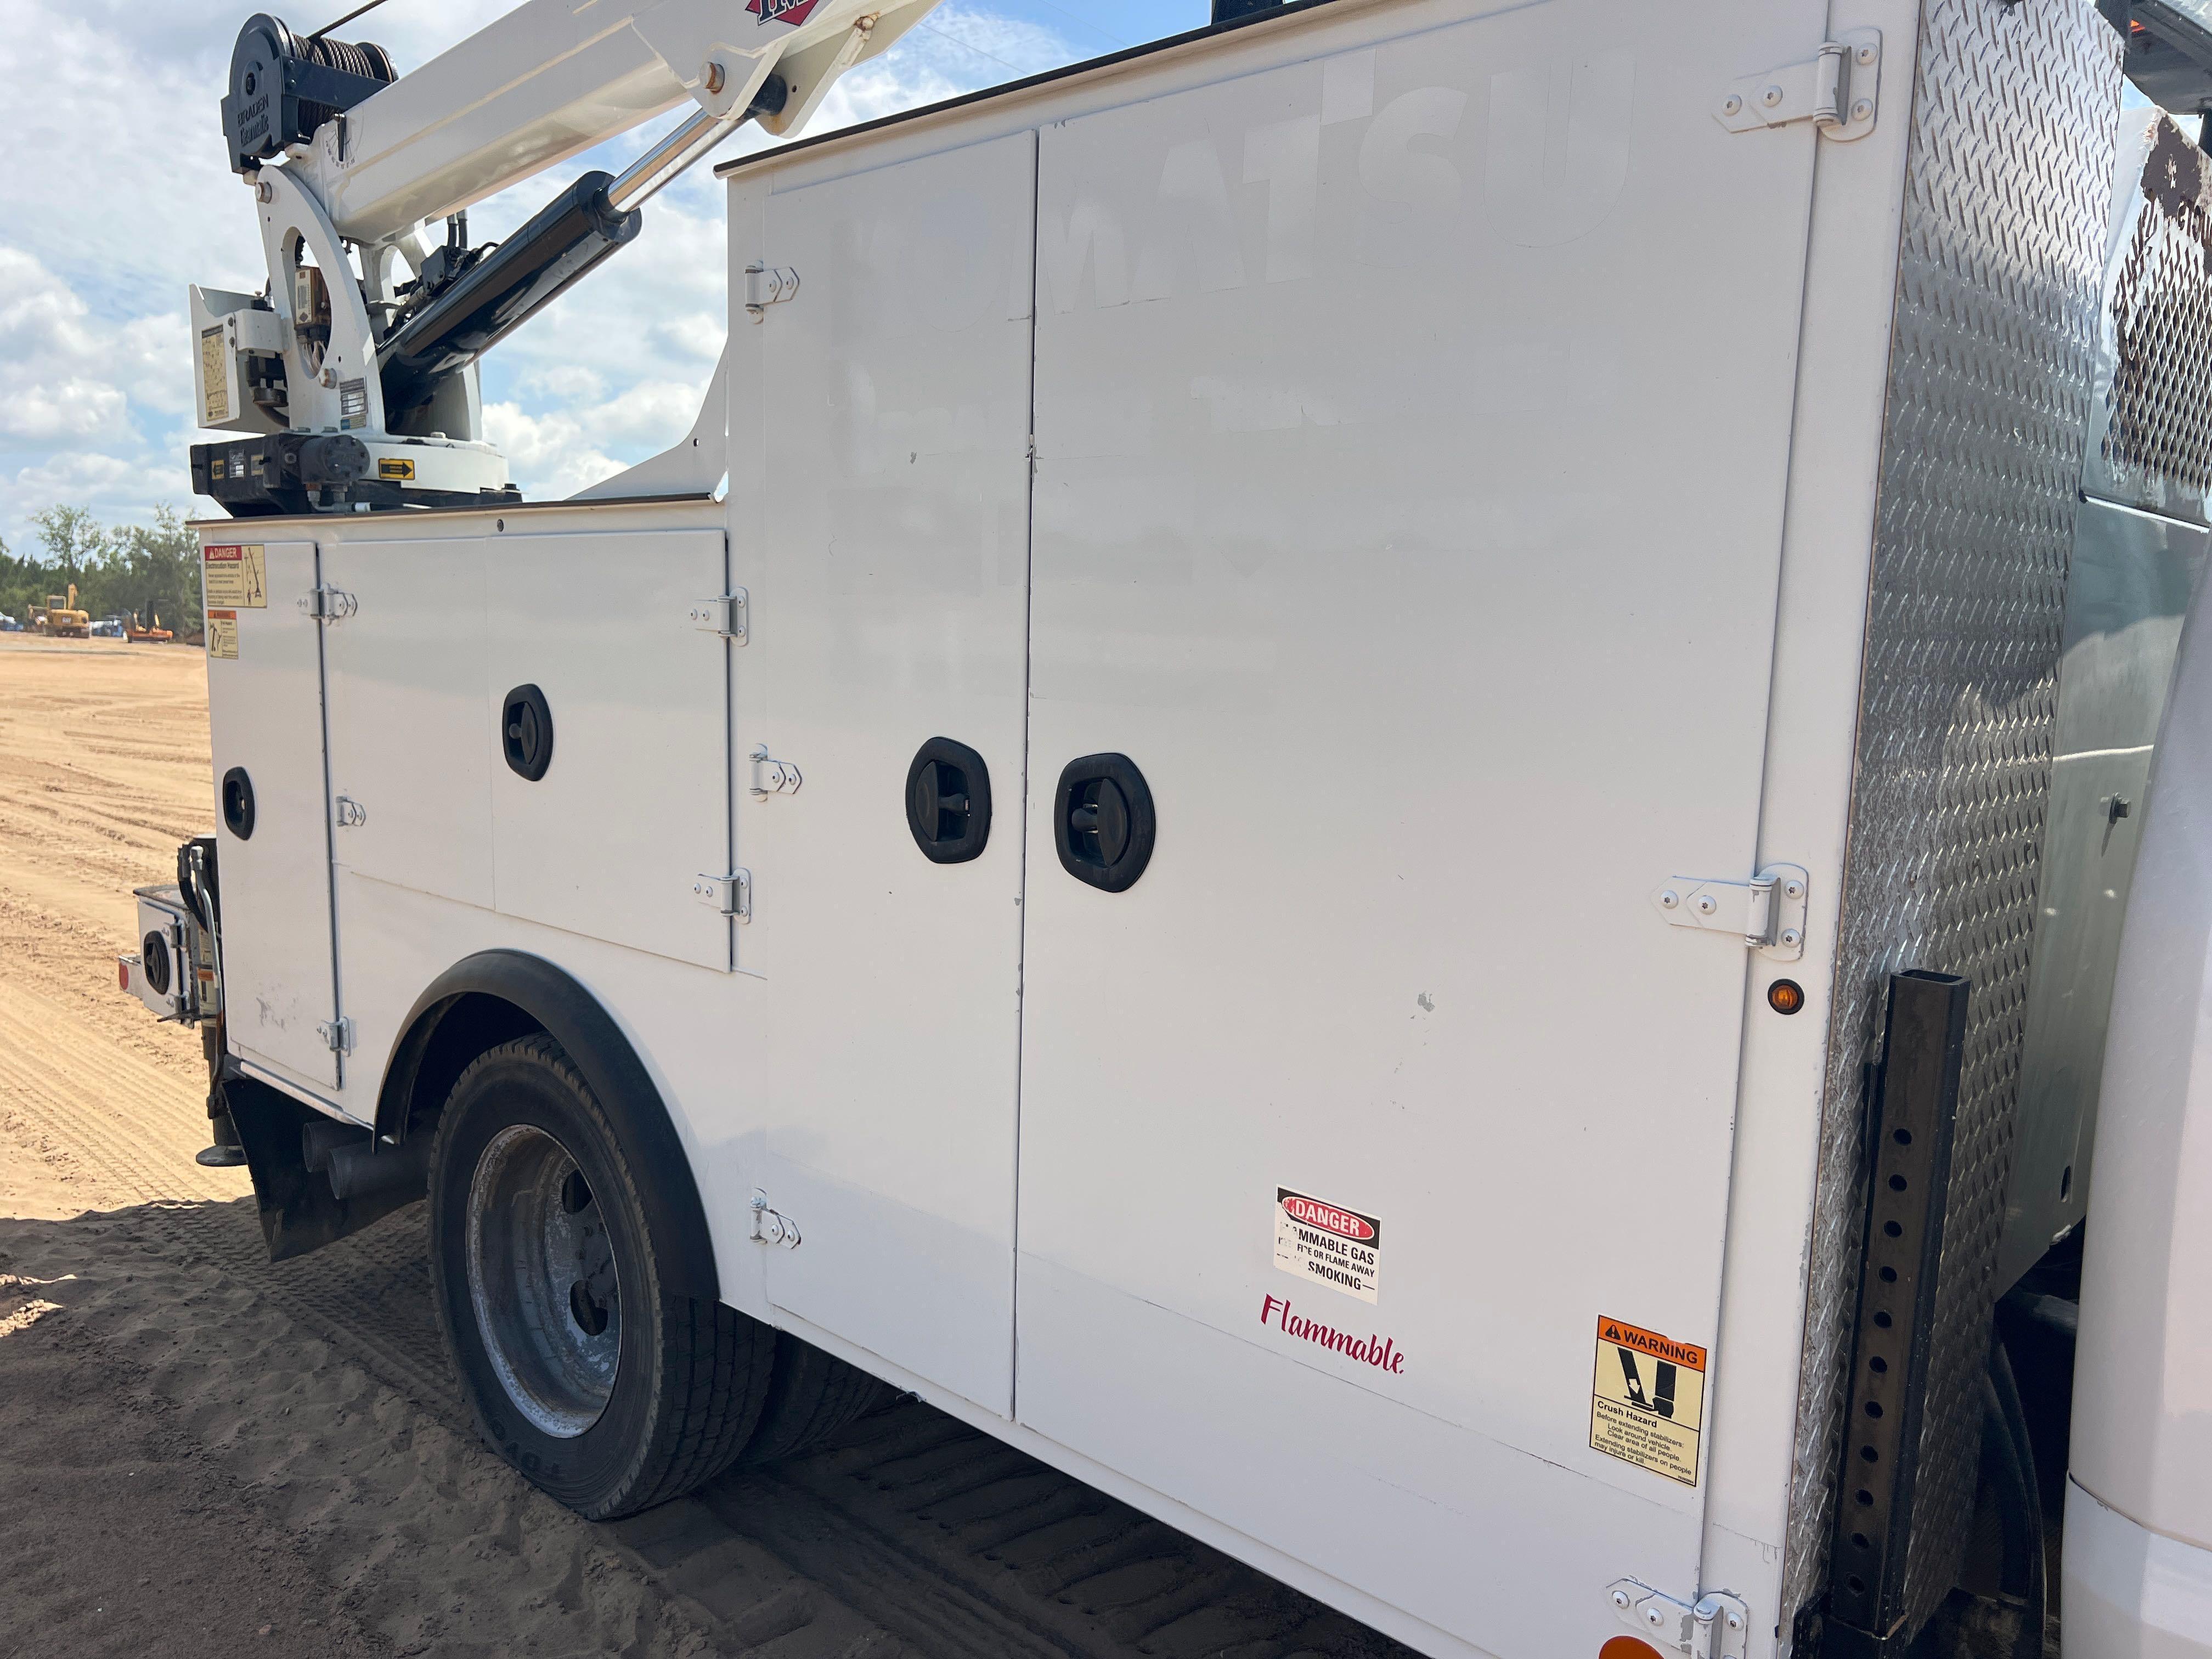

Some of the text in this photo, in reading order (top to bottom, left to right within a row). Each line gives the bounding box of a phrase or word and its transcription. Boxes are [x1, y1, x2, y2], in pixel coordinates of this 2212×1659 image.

[238, 92, 269, 127] BRADEN
[215, 547, 237, 558] DANGER
[1295, 1200, 1359, 1237] DANGER
[1313, 1249, 1324, 1260] OR
[1325, 1253, 1350, 1269] FLAME
[1351, 1263, 1375, 1278] AWAY
[1351, 1246, 1374, 1265] GAS
[1308, 1261, 1361, 1290] SMOKING
[1624, 1329, 1697, 1364] WARNING
[1598, 1401, 1657, 1427] Crush Hazard
[1596, 1411, 1684, 1448] Before extending stabilizers:
[1607, 1423, 1672, 1452] Look around vehicle.
[1594, 1442, 1608, 1452] may
[1609, 1446, 1626, 1457] injure
[1635, 1455, 1646, 1465] kill.
[1595, 1434, 1626, 1451] Extending
[1627, 1447, 1658, 1463] stabilizers
[1669, 1463, 1691, 1475] people
[1607, 1430, 1624, 1440] Clear
[1625, 1437, 1639, 1447] area
[1658, 1449, 1681, 1462] people.
